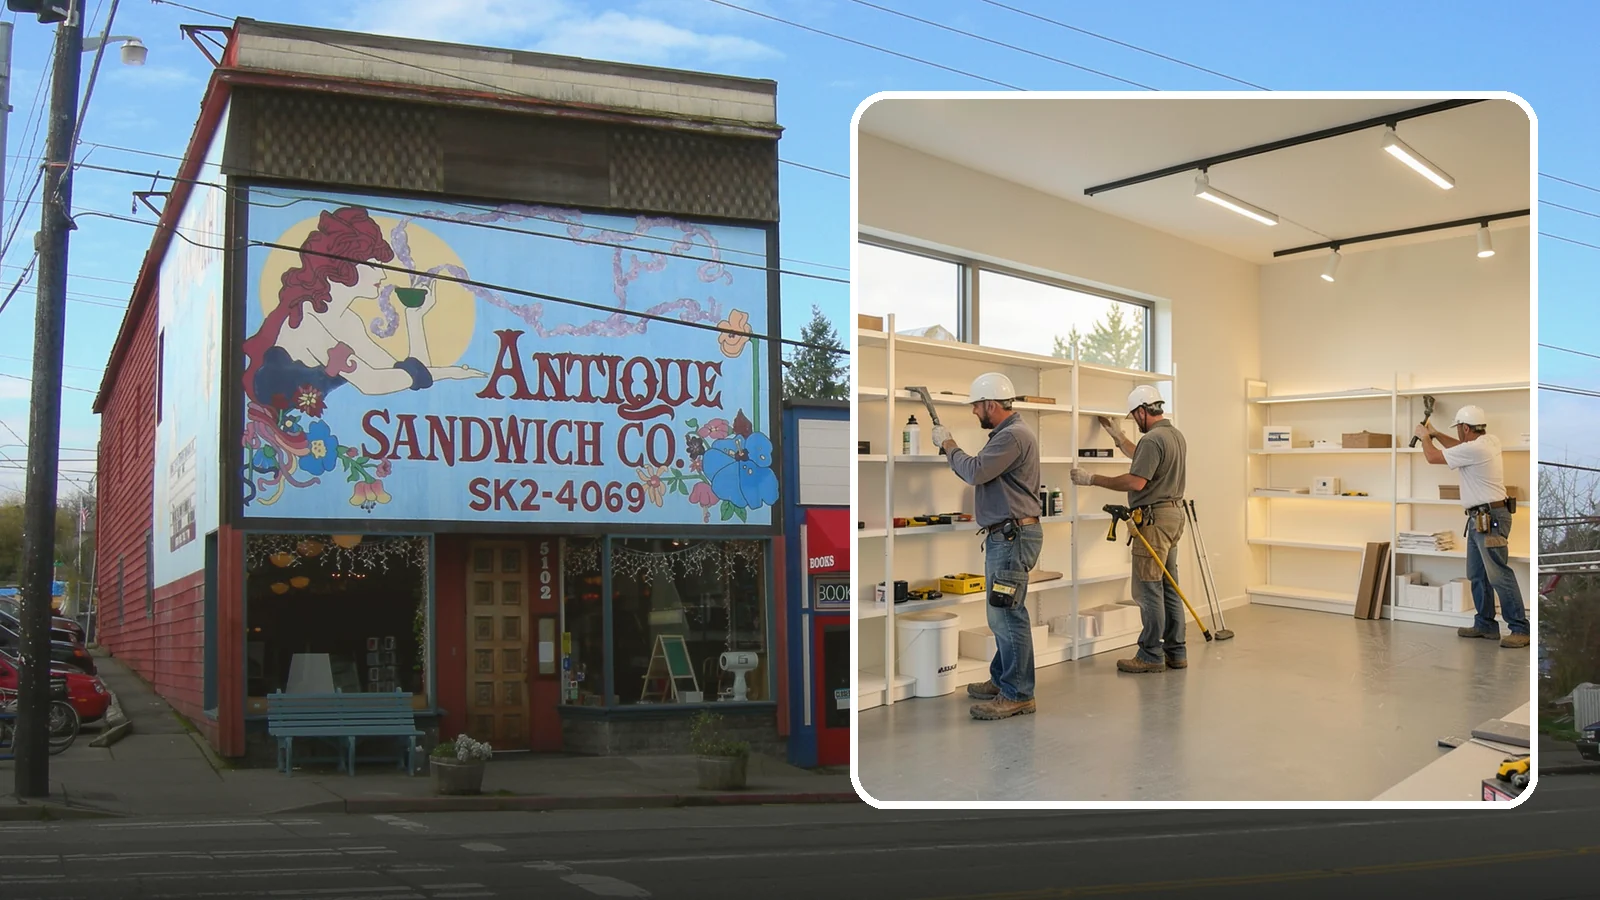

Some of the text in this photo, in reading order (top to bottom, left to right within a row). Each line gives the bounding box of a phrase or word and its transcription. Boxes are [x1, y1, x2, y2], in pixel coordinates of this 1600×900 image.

[475, 328, 724, 421] ANTIQUE
[361, 408, 685, 469] SANDWICH CO.
[468, 476, 647, 514] SK2-4069
[540, 541, 551, 599] 5102
[809, 555, 834, 568] BOOKS
